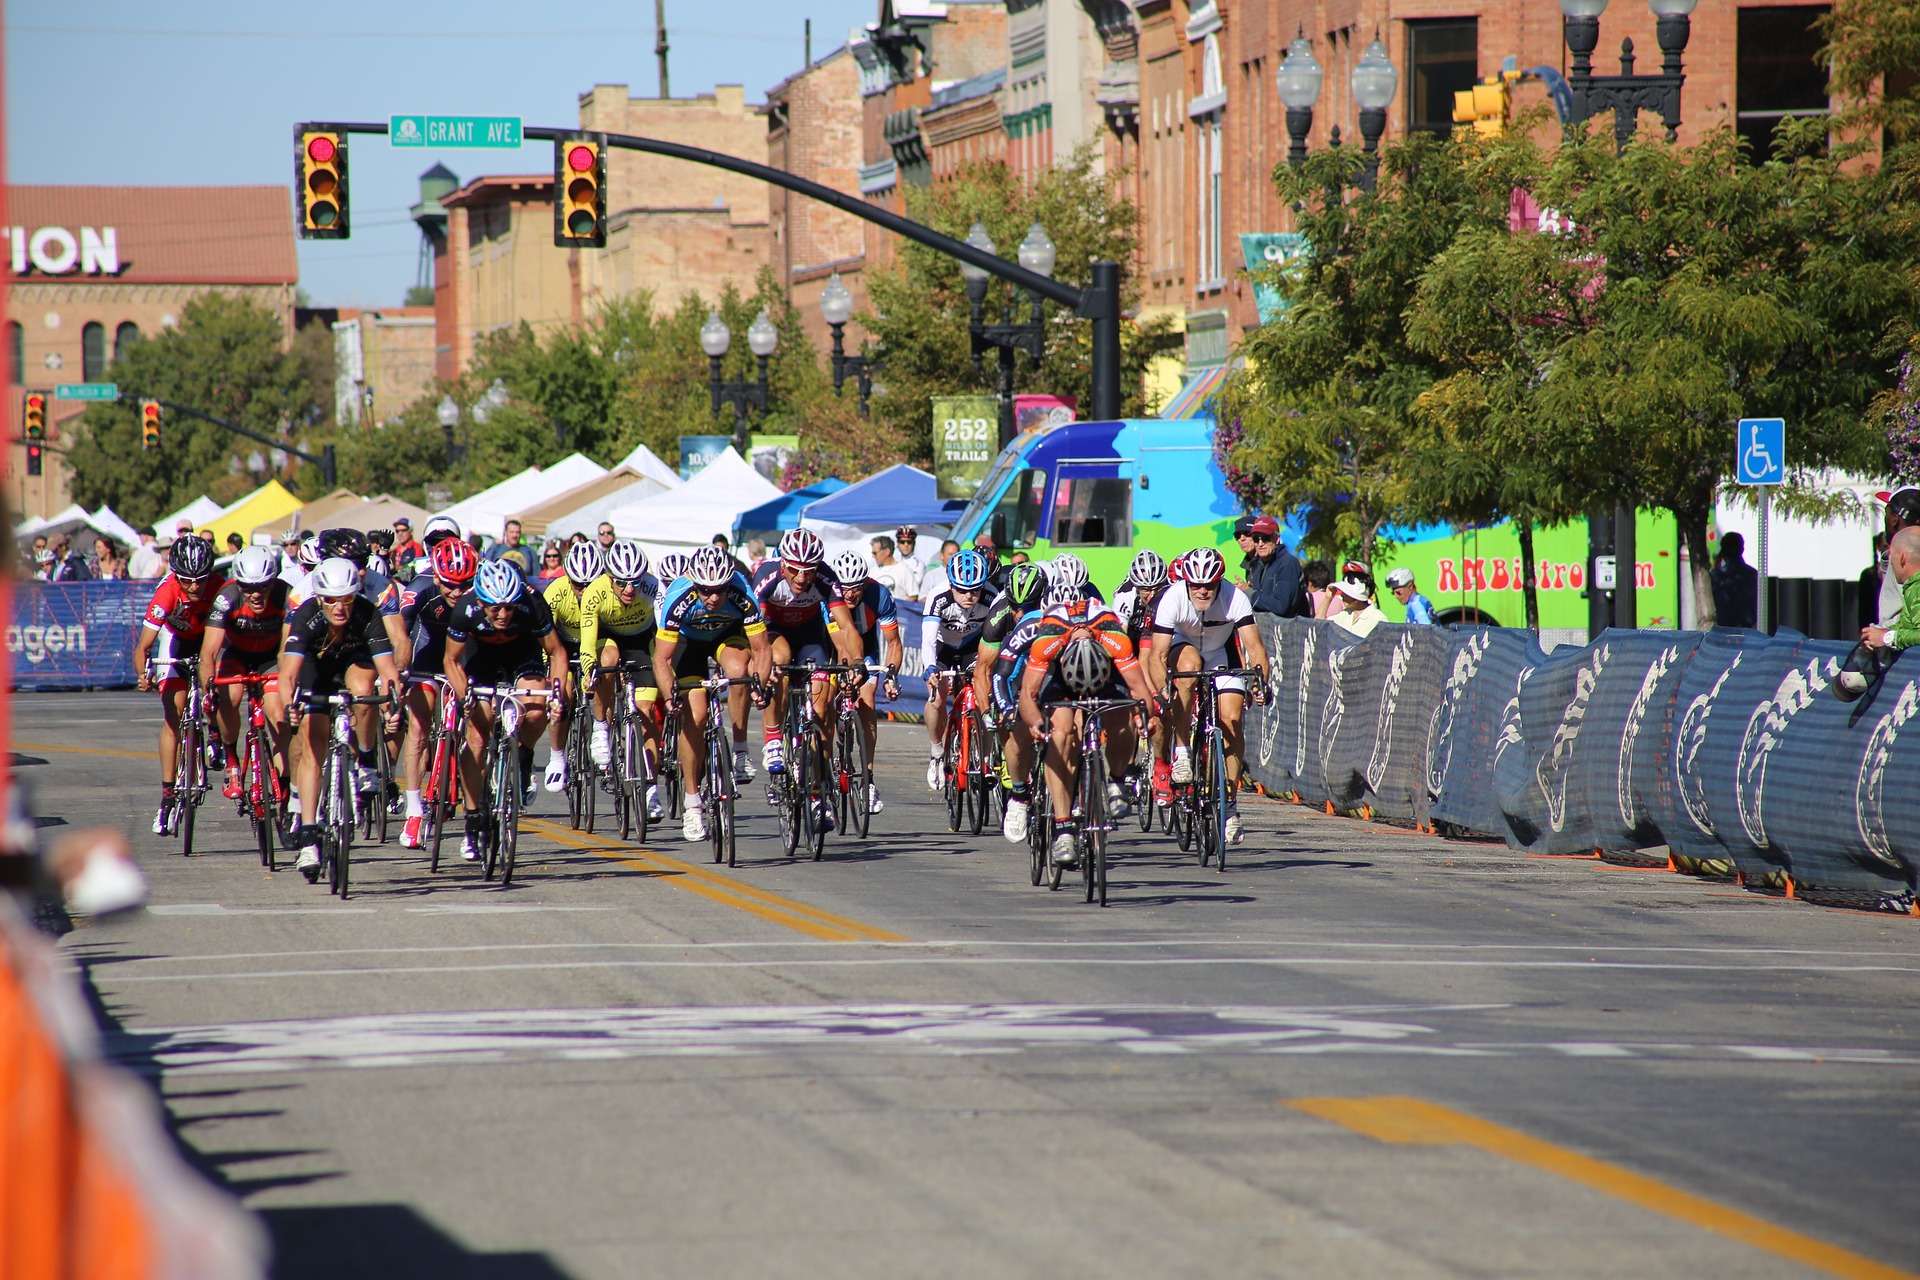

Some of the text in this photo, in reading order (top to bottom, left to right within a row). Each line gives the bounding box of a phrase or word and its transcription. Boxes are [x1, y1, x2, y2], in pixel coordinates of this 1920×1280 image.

[429, 121, 519, 143] GRANT AVE.
[944, 418, 988, 441] 252
[944, 450, 989, 462] TRAILS
[1437, 556, 1656, 592] RMBitrom
[581, 588, 608, 629] bikesole
[673, 593, 695, 619] SKLZ
[4, 623, 87, 664] agen
[1009, 622, 1037, 650] SKLZ
